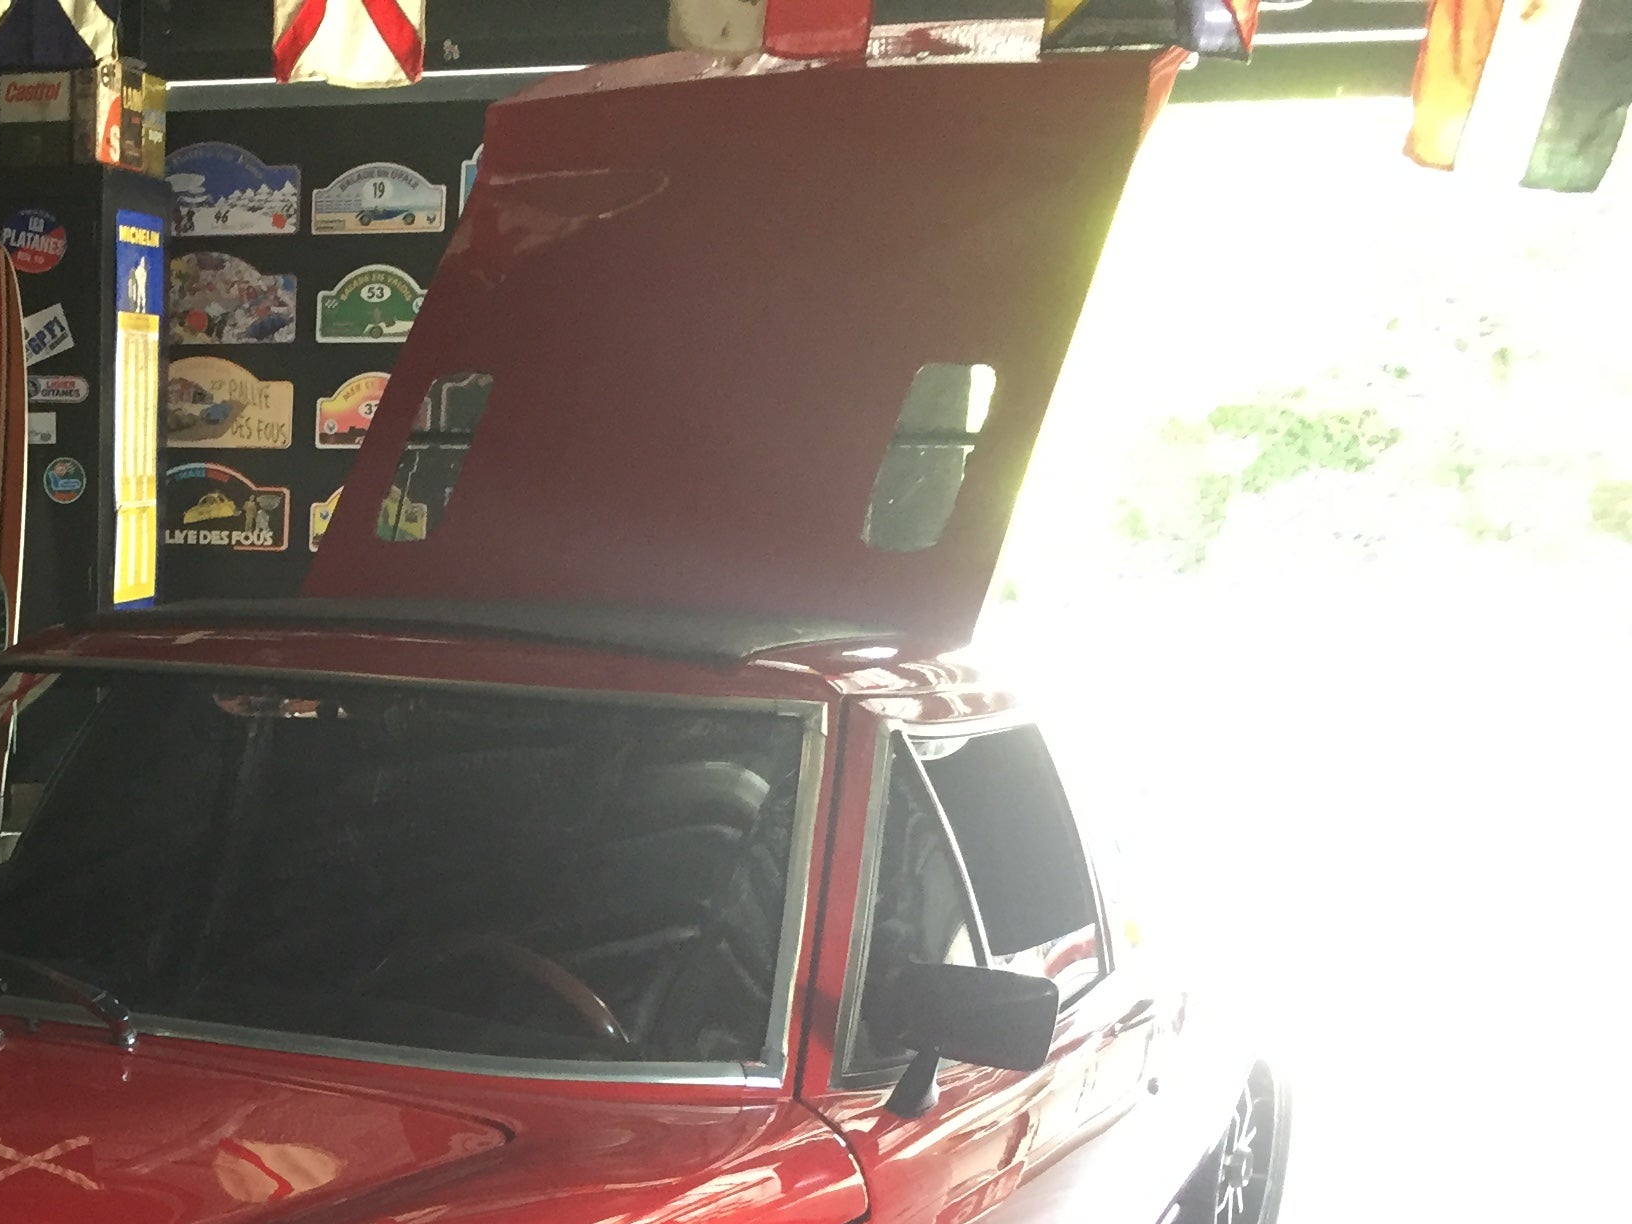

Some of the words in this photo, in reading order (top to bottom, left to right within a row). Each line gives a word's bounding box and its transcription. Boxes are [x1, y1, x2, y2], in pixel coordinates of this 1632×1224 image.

[5, 81, 61, 103] Castrol
[372, 181, 386, 198] 19
[1, 227, 66, 255] PLATANES
[119, 225, 160, 248] MICHELIN
[367, 286, 384, 299] 53
[41, 389, 80, 397] GITANES
[199, 529, 230, 545] DES
[231, 529, 274, 546] FOUS
